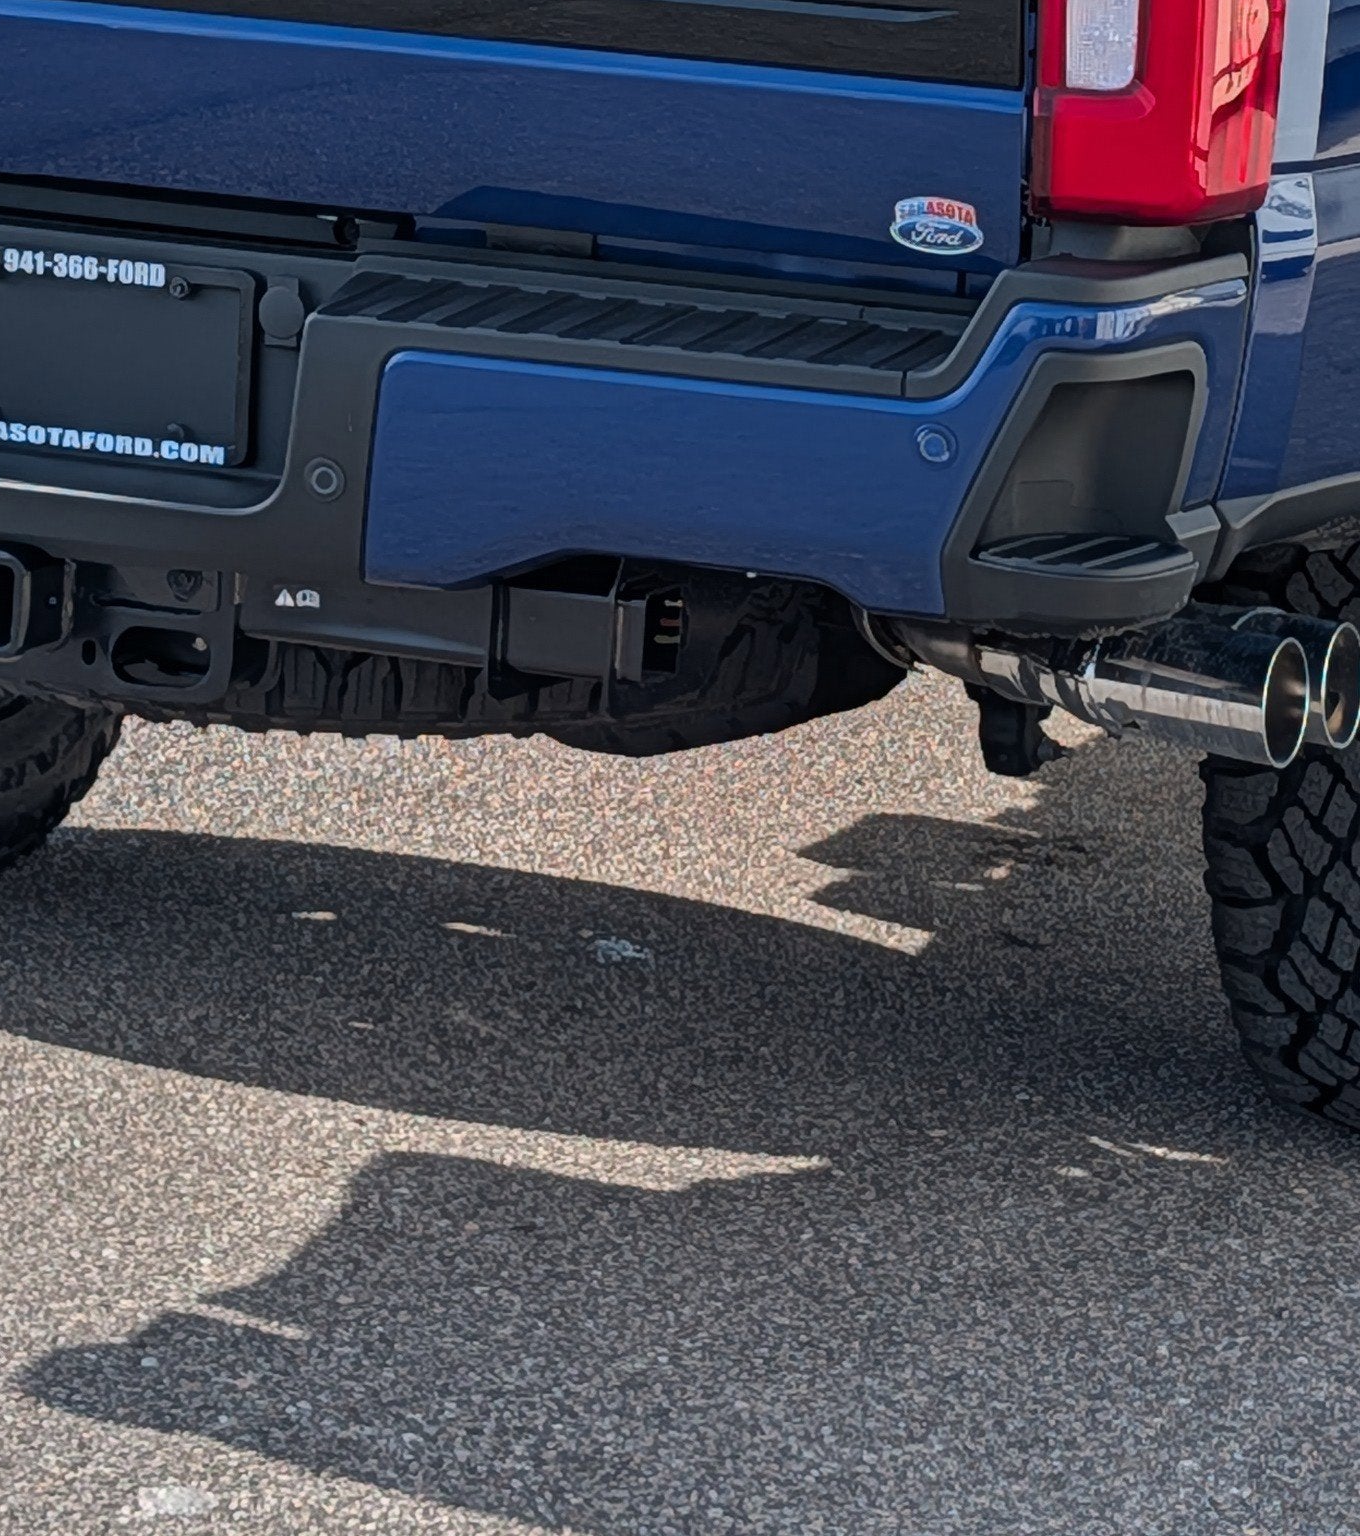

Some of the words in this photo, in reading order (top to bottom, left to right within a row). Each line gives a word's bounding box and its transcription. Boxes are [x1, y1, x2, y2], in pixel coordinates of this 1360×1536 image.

[899, 201, 974, 227] SARASOTA
[910, 220, 964, 245] Ford
[3, 248, 166, 288] 941-366-FORD
